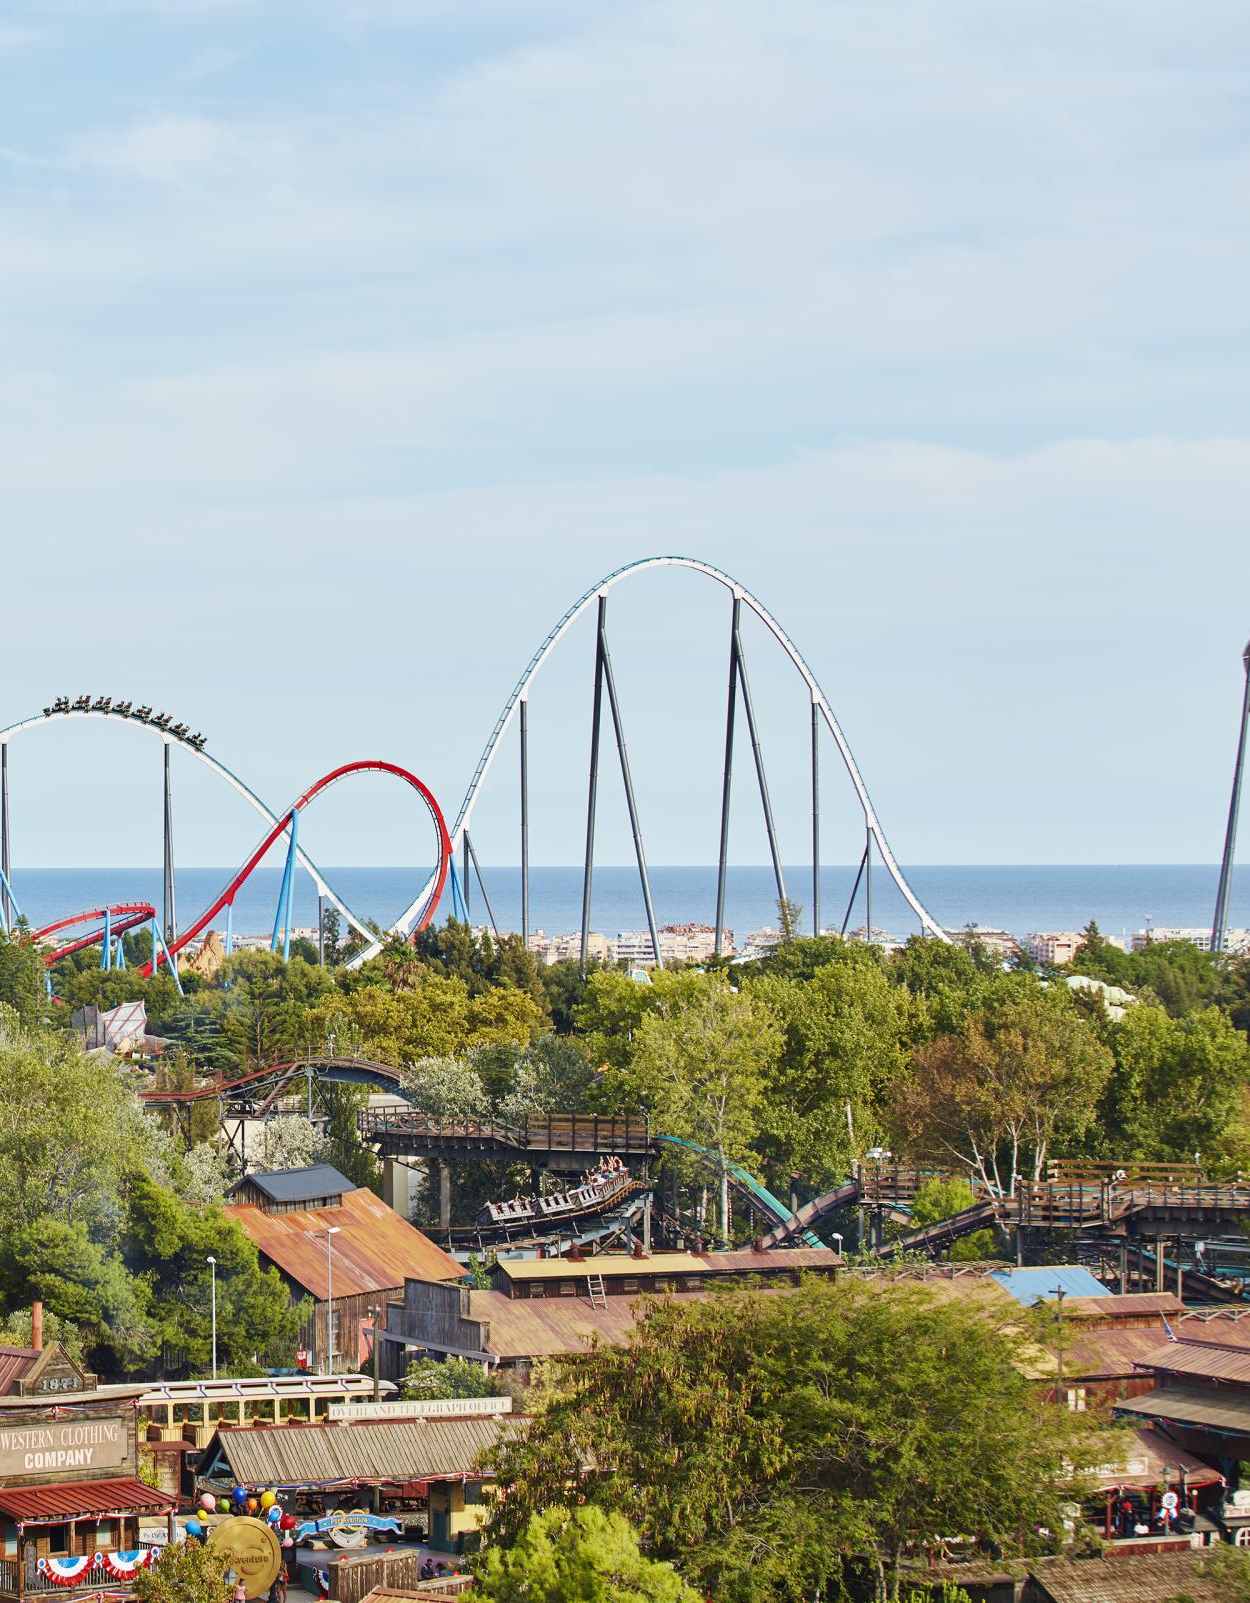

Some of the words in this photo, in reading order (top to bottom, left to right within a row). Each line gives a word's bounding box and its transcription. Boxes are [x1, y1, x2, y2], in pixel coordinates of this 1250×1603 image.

[0, 1429, 54, 1450] WESTERN
[61, 1424, 118, 1447] CLOTHING
[24, 1448, 93, 1469] COMPANY
